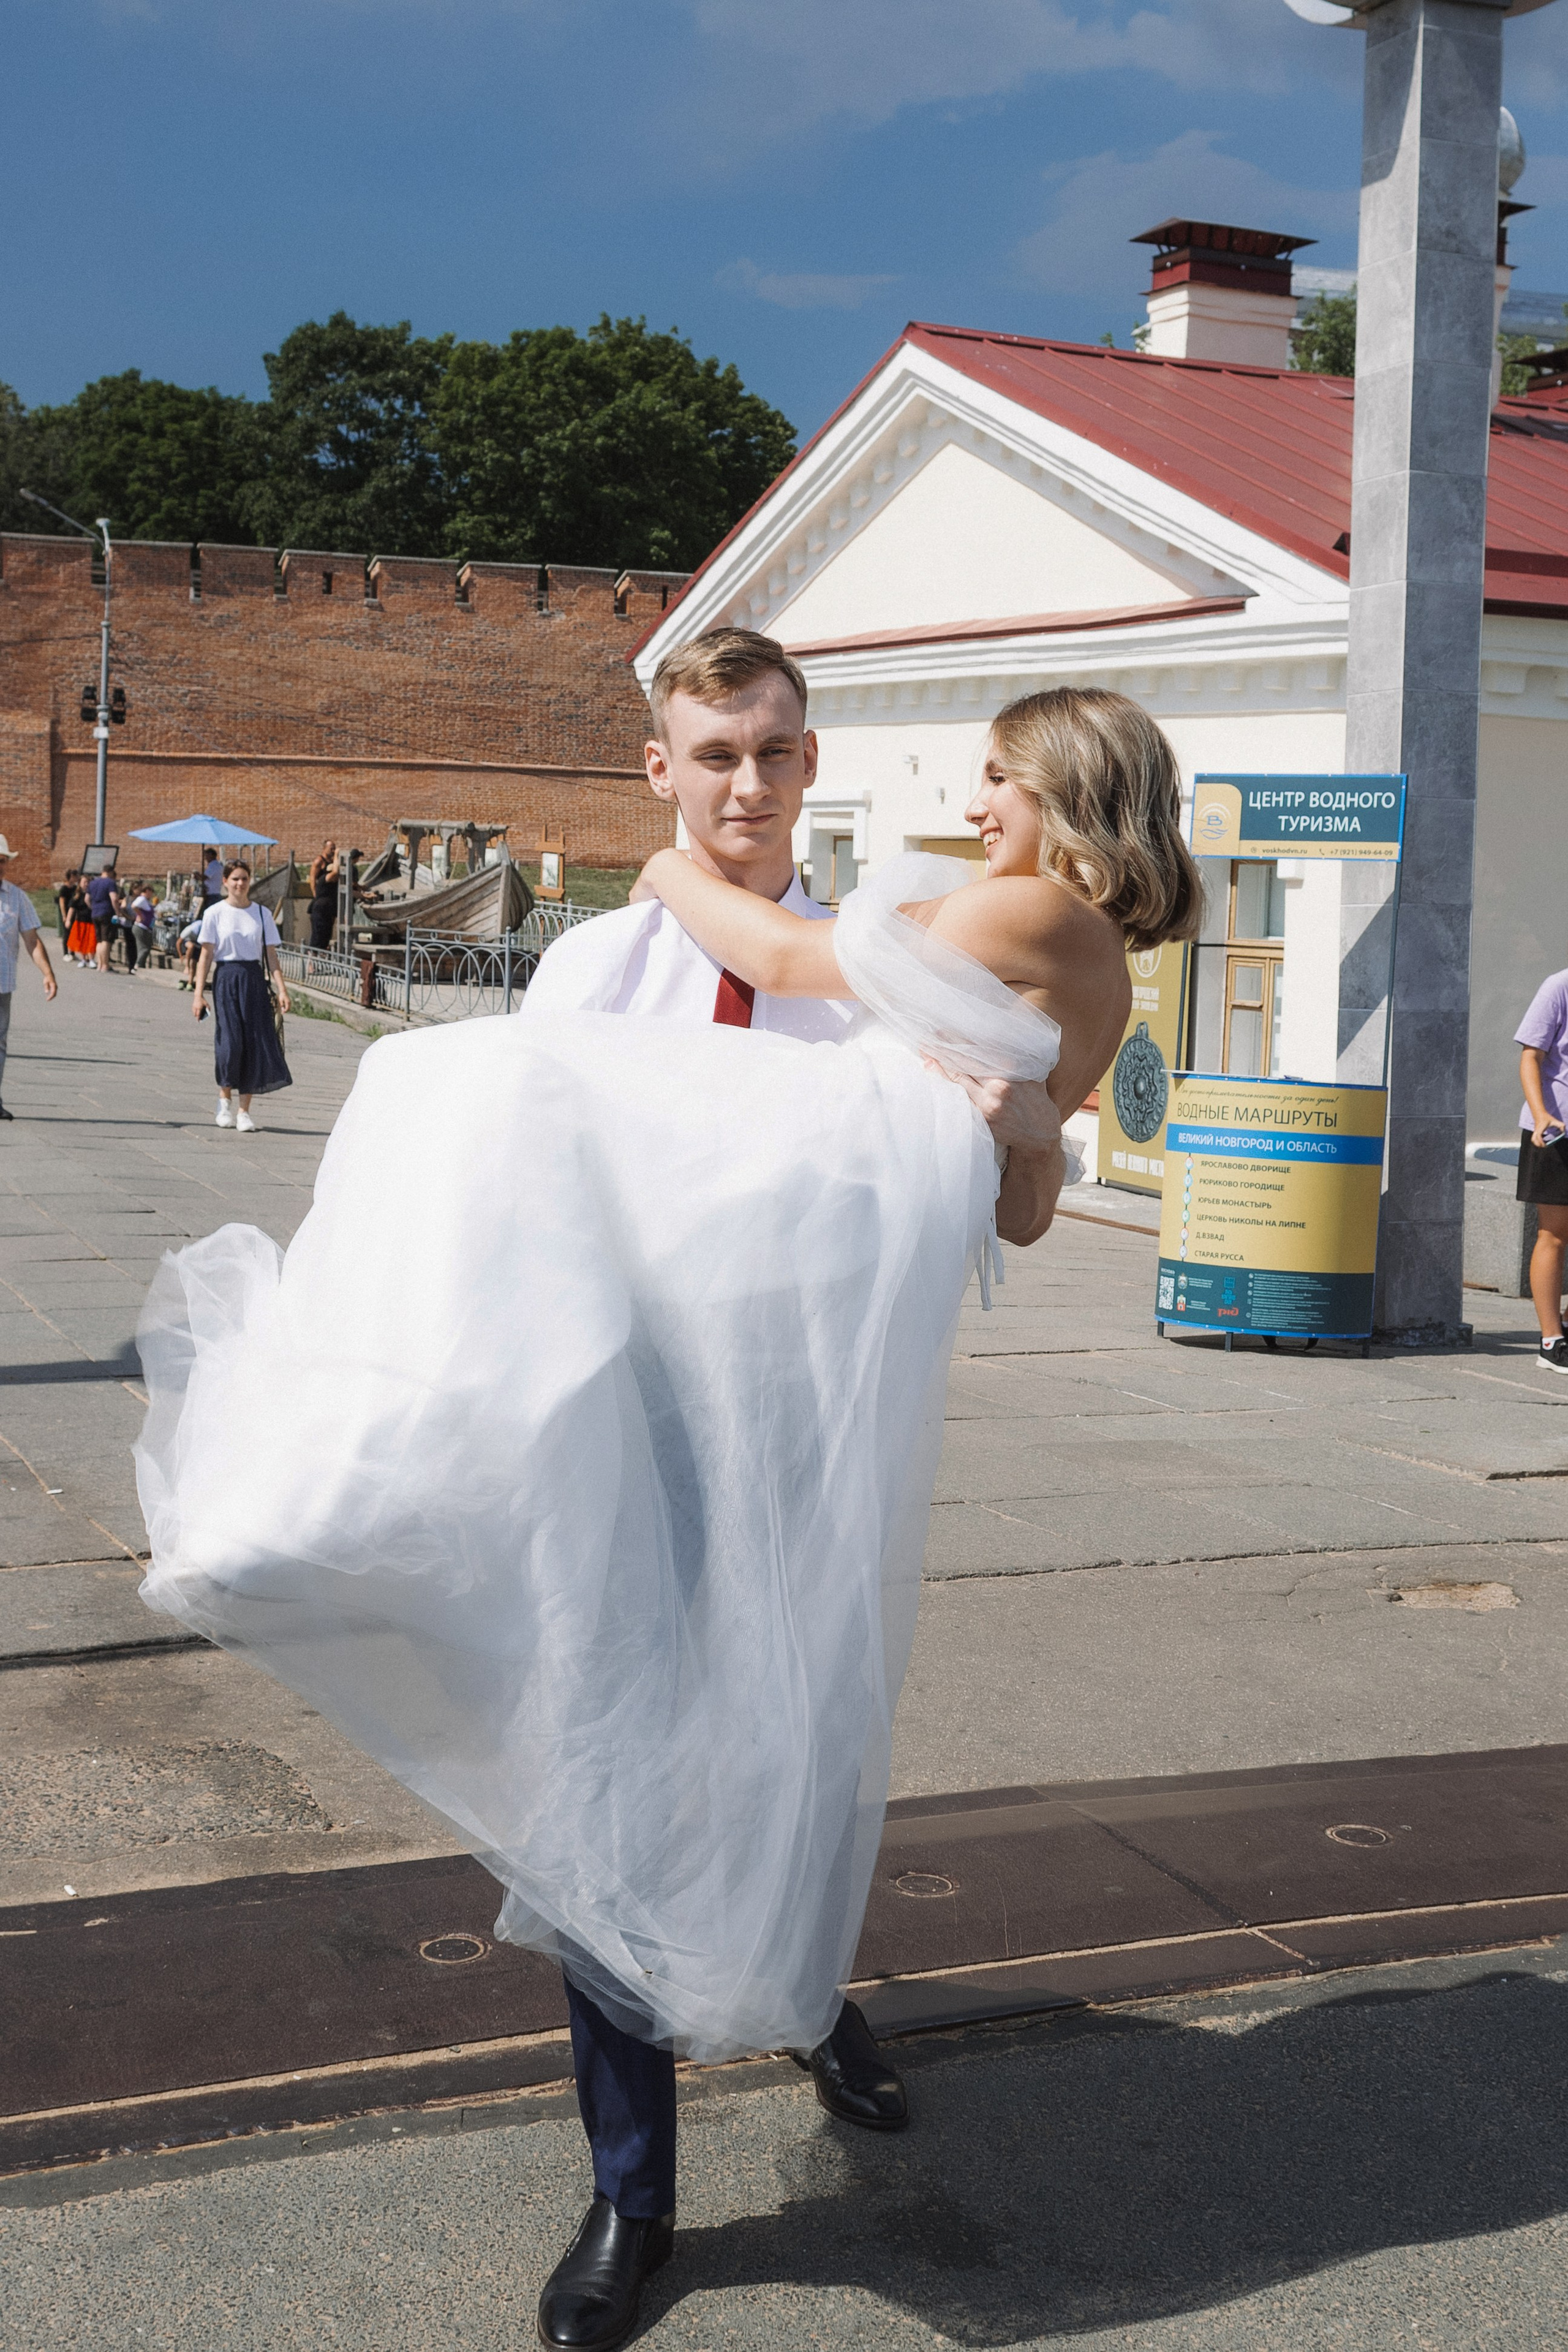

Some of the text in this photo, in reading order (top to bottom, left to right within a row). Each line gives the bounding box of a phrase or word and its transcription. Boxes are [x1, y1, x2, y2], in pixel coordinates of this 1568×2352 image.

[1249, 791, 1396, 811] ЦЕНТР ВОДНОГО
[1278, 815, 1362, 832] ТУРИЗМА
[1281, 1095, 1292, 1104] за
[1295, 1096, 1315, 1105] один
[1177, 1102, 1337, 1128] ВОДНЫЕ МАРШРУТЫ
[1178, 1133, 1337, 1153] ВЕЛИКИЙ НОВГОРОД И ОБЛАСТЬ
[1201, 1160, 1291, 1174] ЯРОСЛАВОВО ДВОРИЩЕ
[1199, 1178, 1285, 1191] РЮРИКОВО ГОРОДИЩЕ
[1198, 1197, 1272, 1209] ЮРЬЕВ МОНАСТЫРЬ
[1197, 1214, 1227, 1223] ЦЕРКОВЬ
[1229, 1217, 1263, 1226] НИКОЛЫ
[1196, 1232, 1224, 1242] Д.ВЗВАД
[1194, 1250, 1244, 1262] СТАРАЯ РУССА
